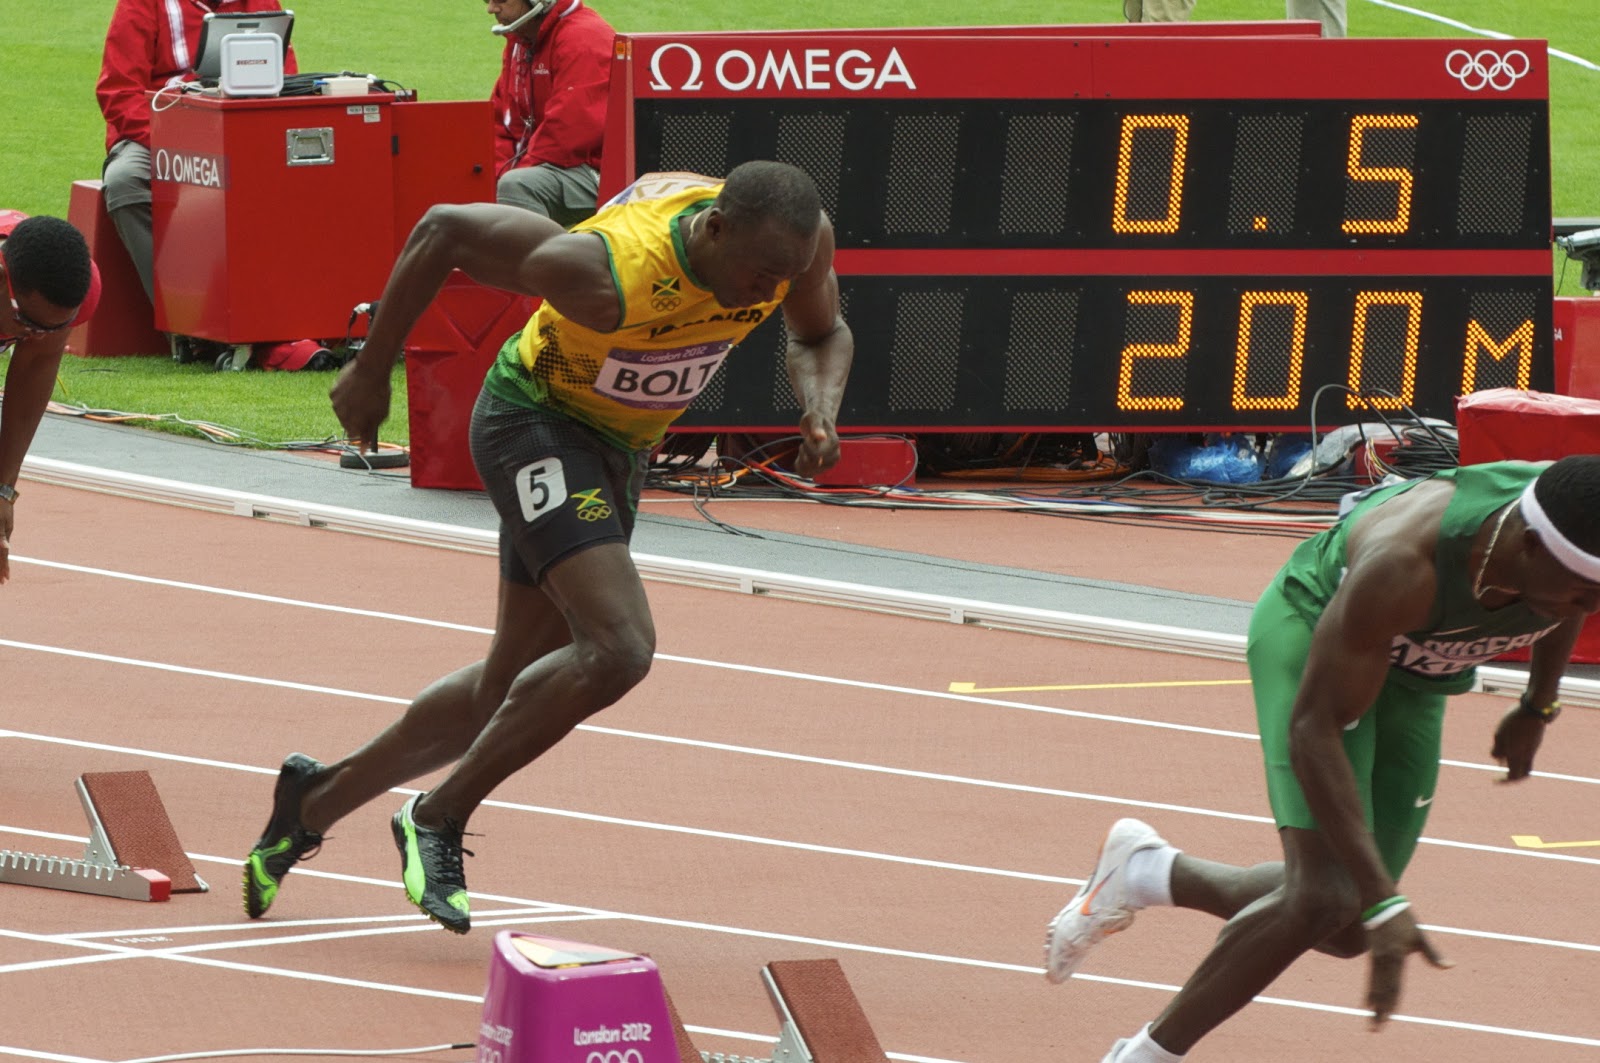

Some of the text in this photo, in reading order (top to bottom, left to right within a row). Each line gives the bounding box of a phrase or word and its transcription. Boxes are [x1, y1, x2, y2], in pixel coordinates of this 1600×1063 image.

[715, 47, 917, 91] OMEGA
[172, 154, 221, 187] OMEGA
[640, 345, 708, 363] London 2012
[612, 361, 718, 396] BOLT
[529, 466, 550, 511] 5
[573, 1022, 652, 1046] London 2012
